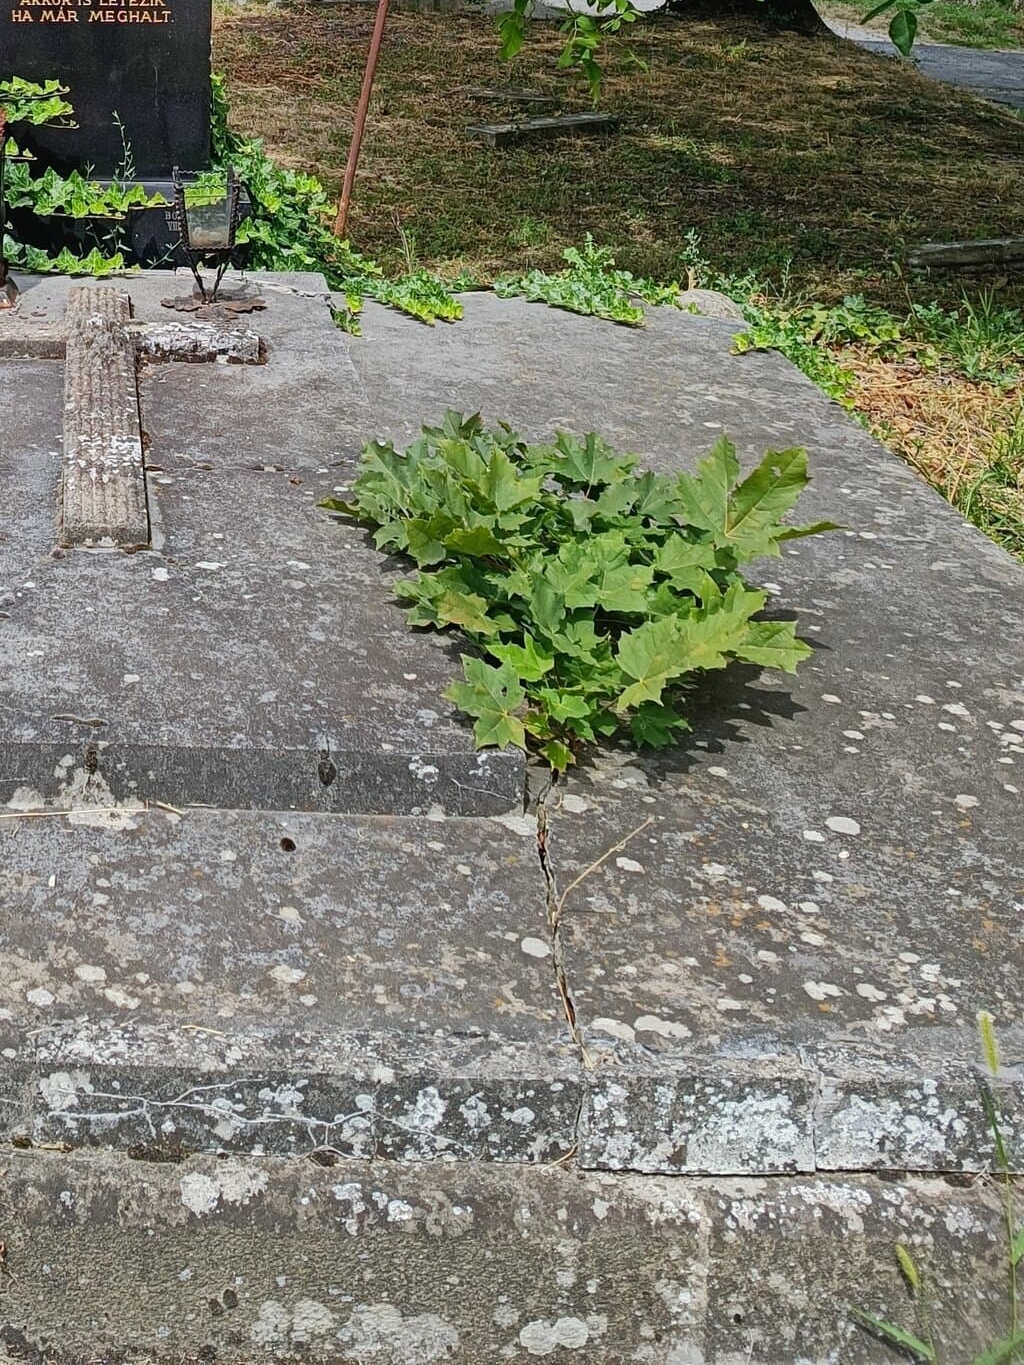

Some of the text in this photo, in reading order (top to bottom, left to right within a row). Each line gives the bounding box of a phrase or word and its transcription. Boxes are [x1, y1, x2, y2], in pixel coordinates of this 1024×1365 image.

[12, 7, 174, 23] HA MÁR MEGHALT.
